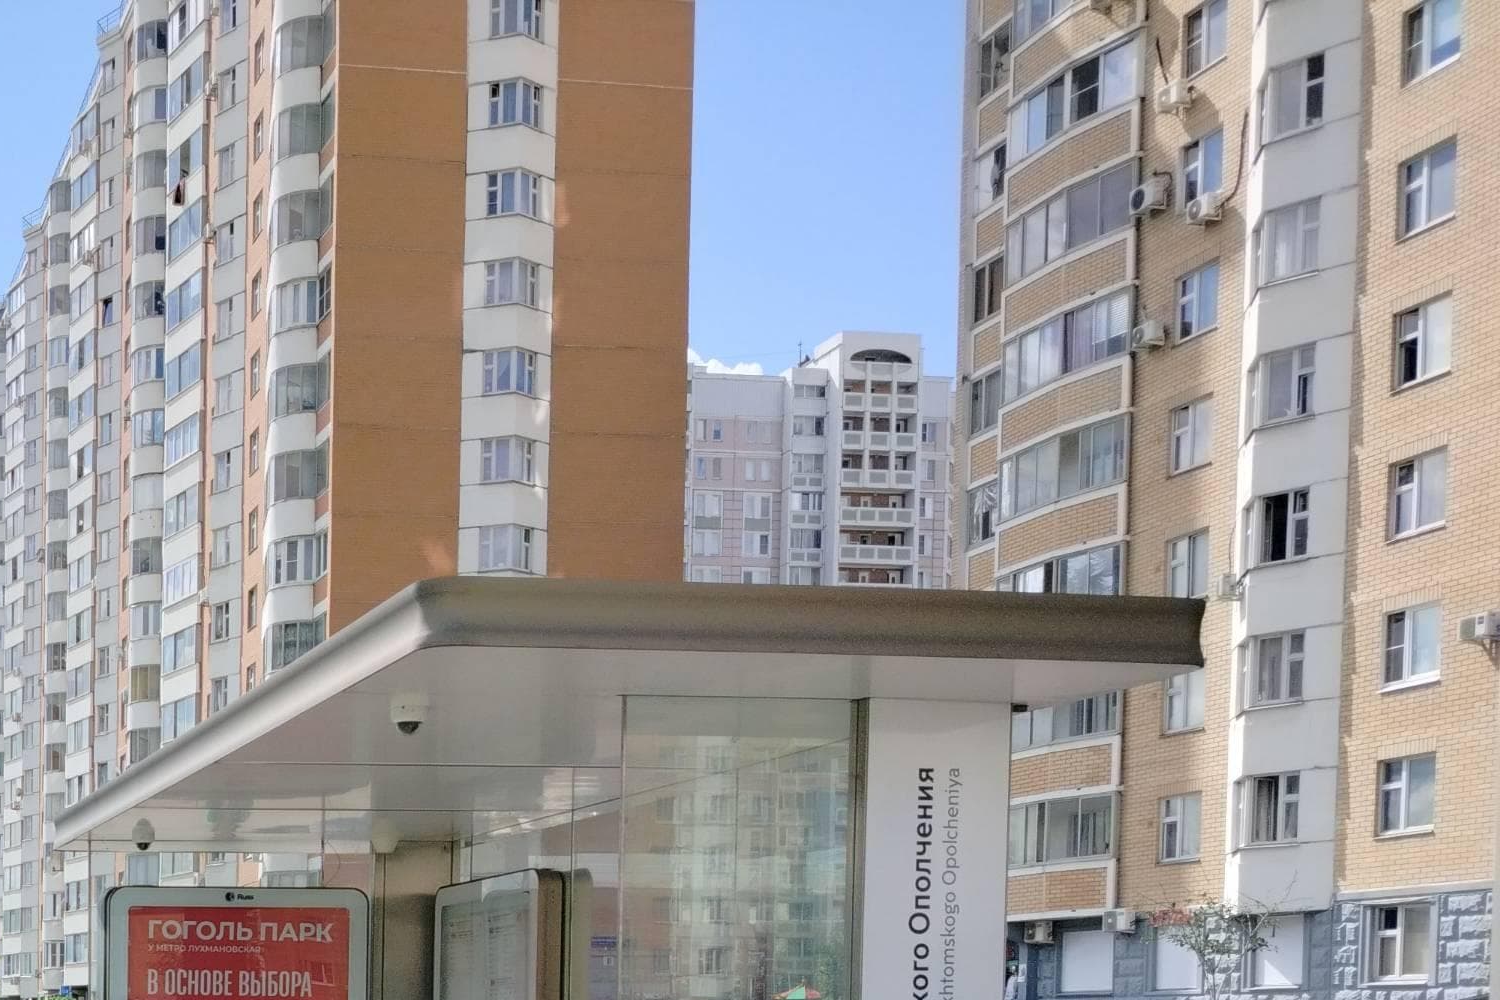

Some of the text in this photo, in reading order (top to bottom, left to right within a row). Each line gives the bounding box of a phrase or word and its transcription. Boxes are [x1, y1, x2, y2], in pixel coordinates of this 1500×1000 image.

[941, 767, 961, 885] Opolcheniya
[908, 767, 935, 935] Ополчения
[147, 919, 333, 943] ГОГОЛЬ ПАРК
[156, 945, 186, 953] МЕТРО
[188, 945, 261, 954] ЛУХМАНОВСКАЯ
[147, 968, 313, 998] В ОСНОВЕ ВЫБОРА
